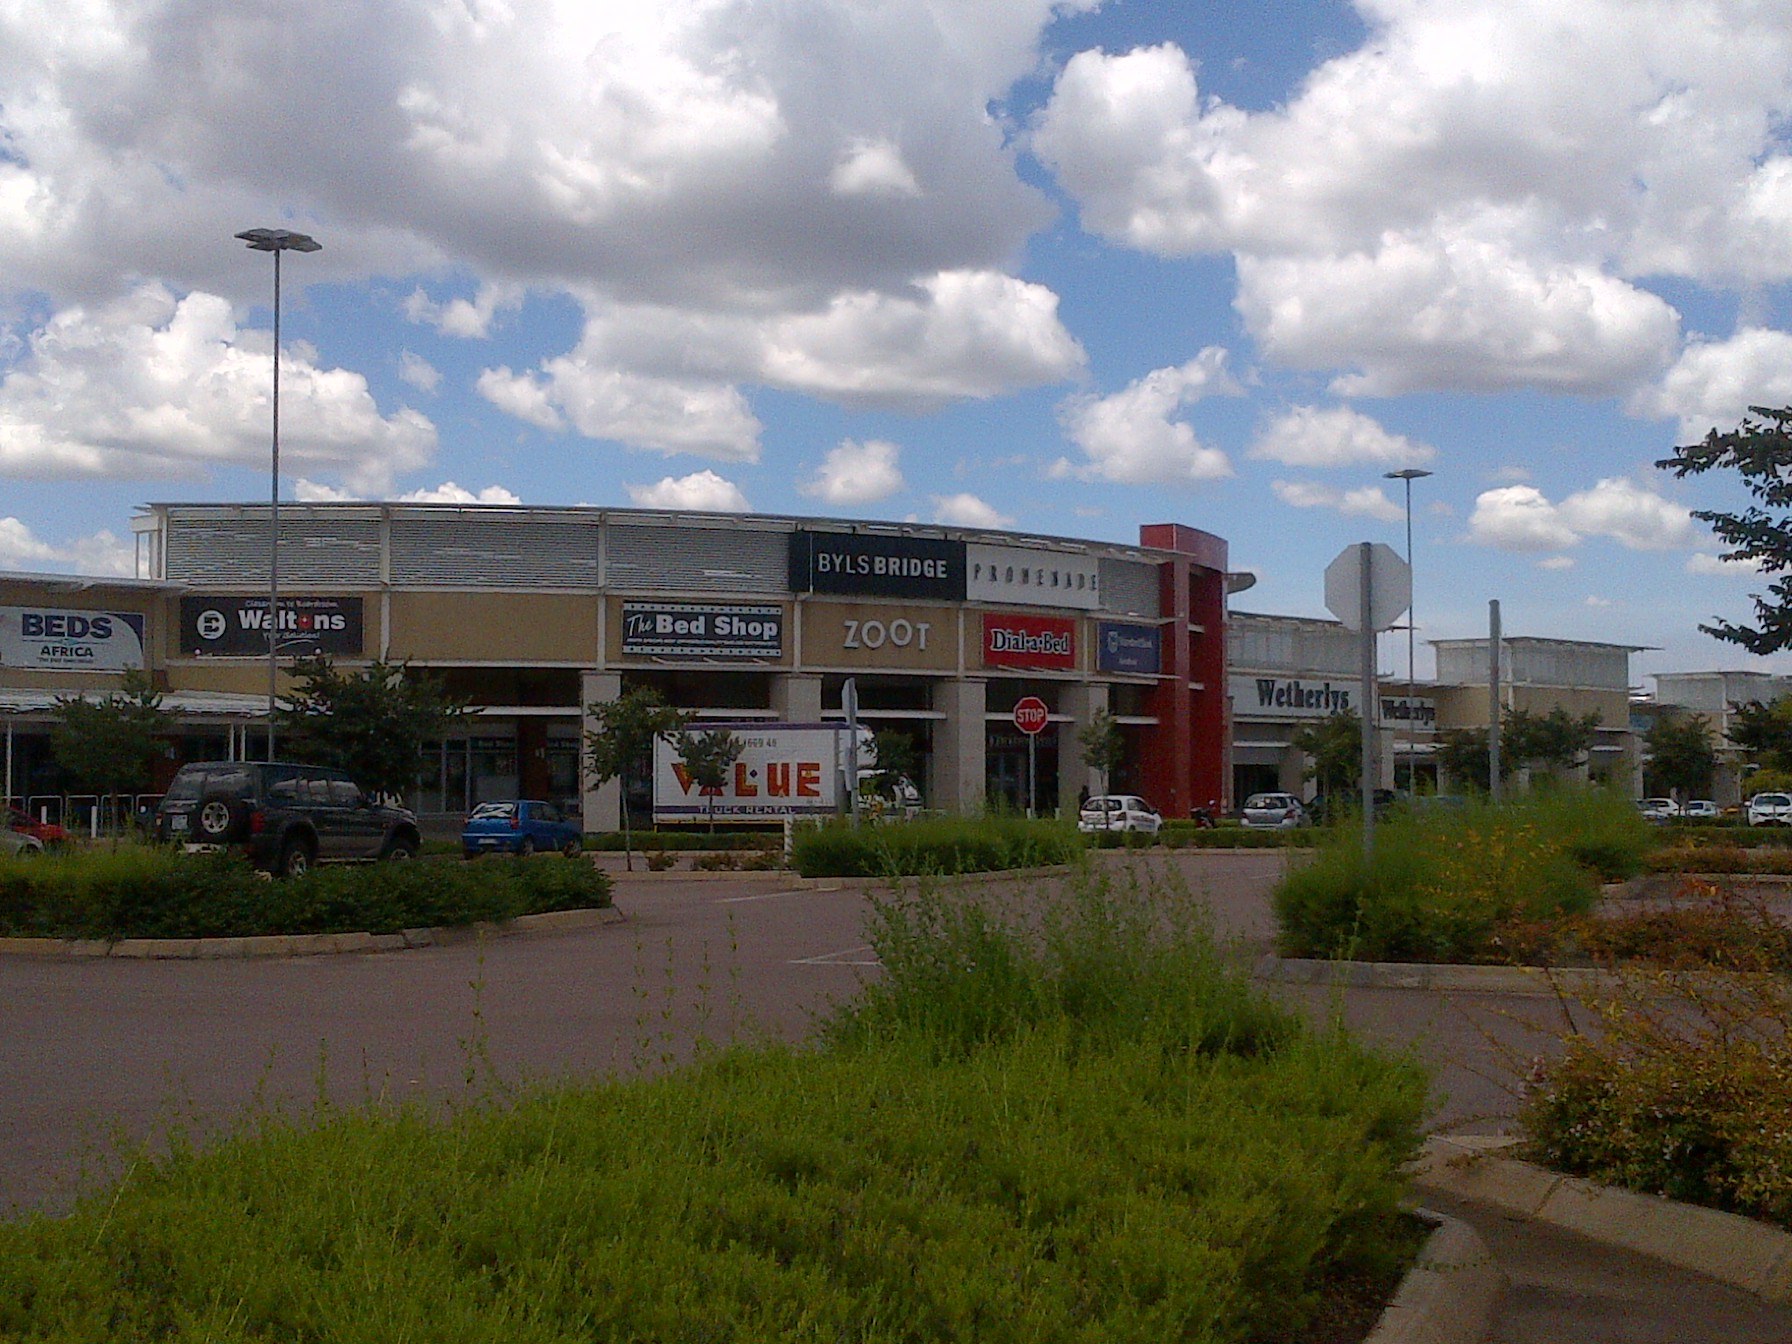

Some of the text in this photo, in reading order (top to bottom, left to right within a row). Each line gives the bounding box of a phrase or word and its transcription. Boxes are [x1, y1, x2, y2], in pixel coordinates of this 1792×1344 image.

[22, 613, 112, 639] BEDS
[627, 614, 778, 640] The Bed Shop
[843, 618, 930, 650] ZOOT
[40, 645, 94, 658] AFRICA
[1256, 679, 1349, 716] Wetherlys
[1017, 708, 1044, 723] STOP
